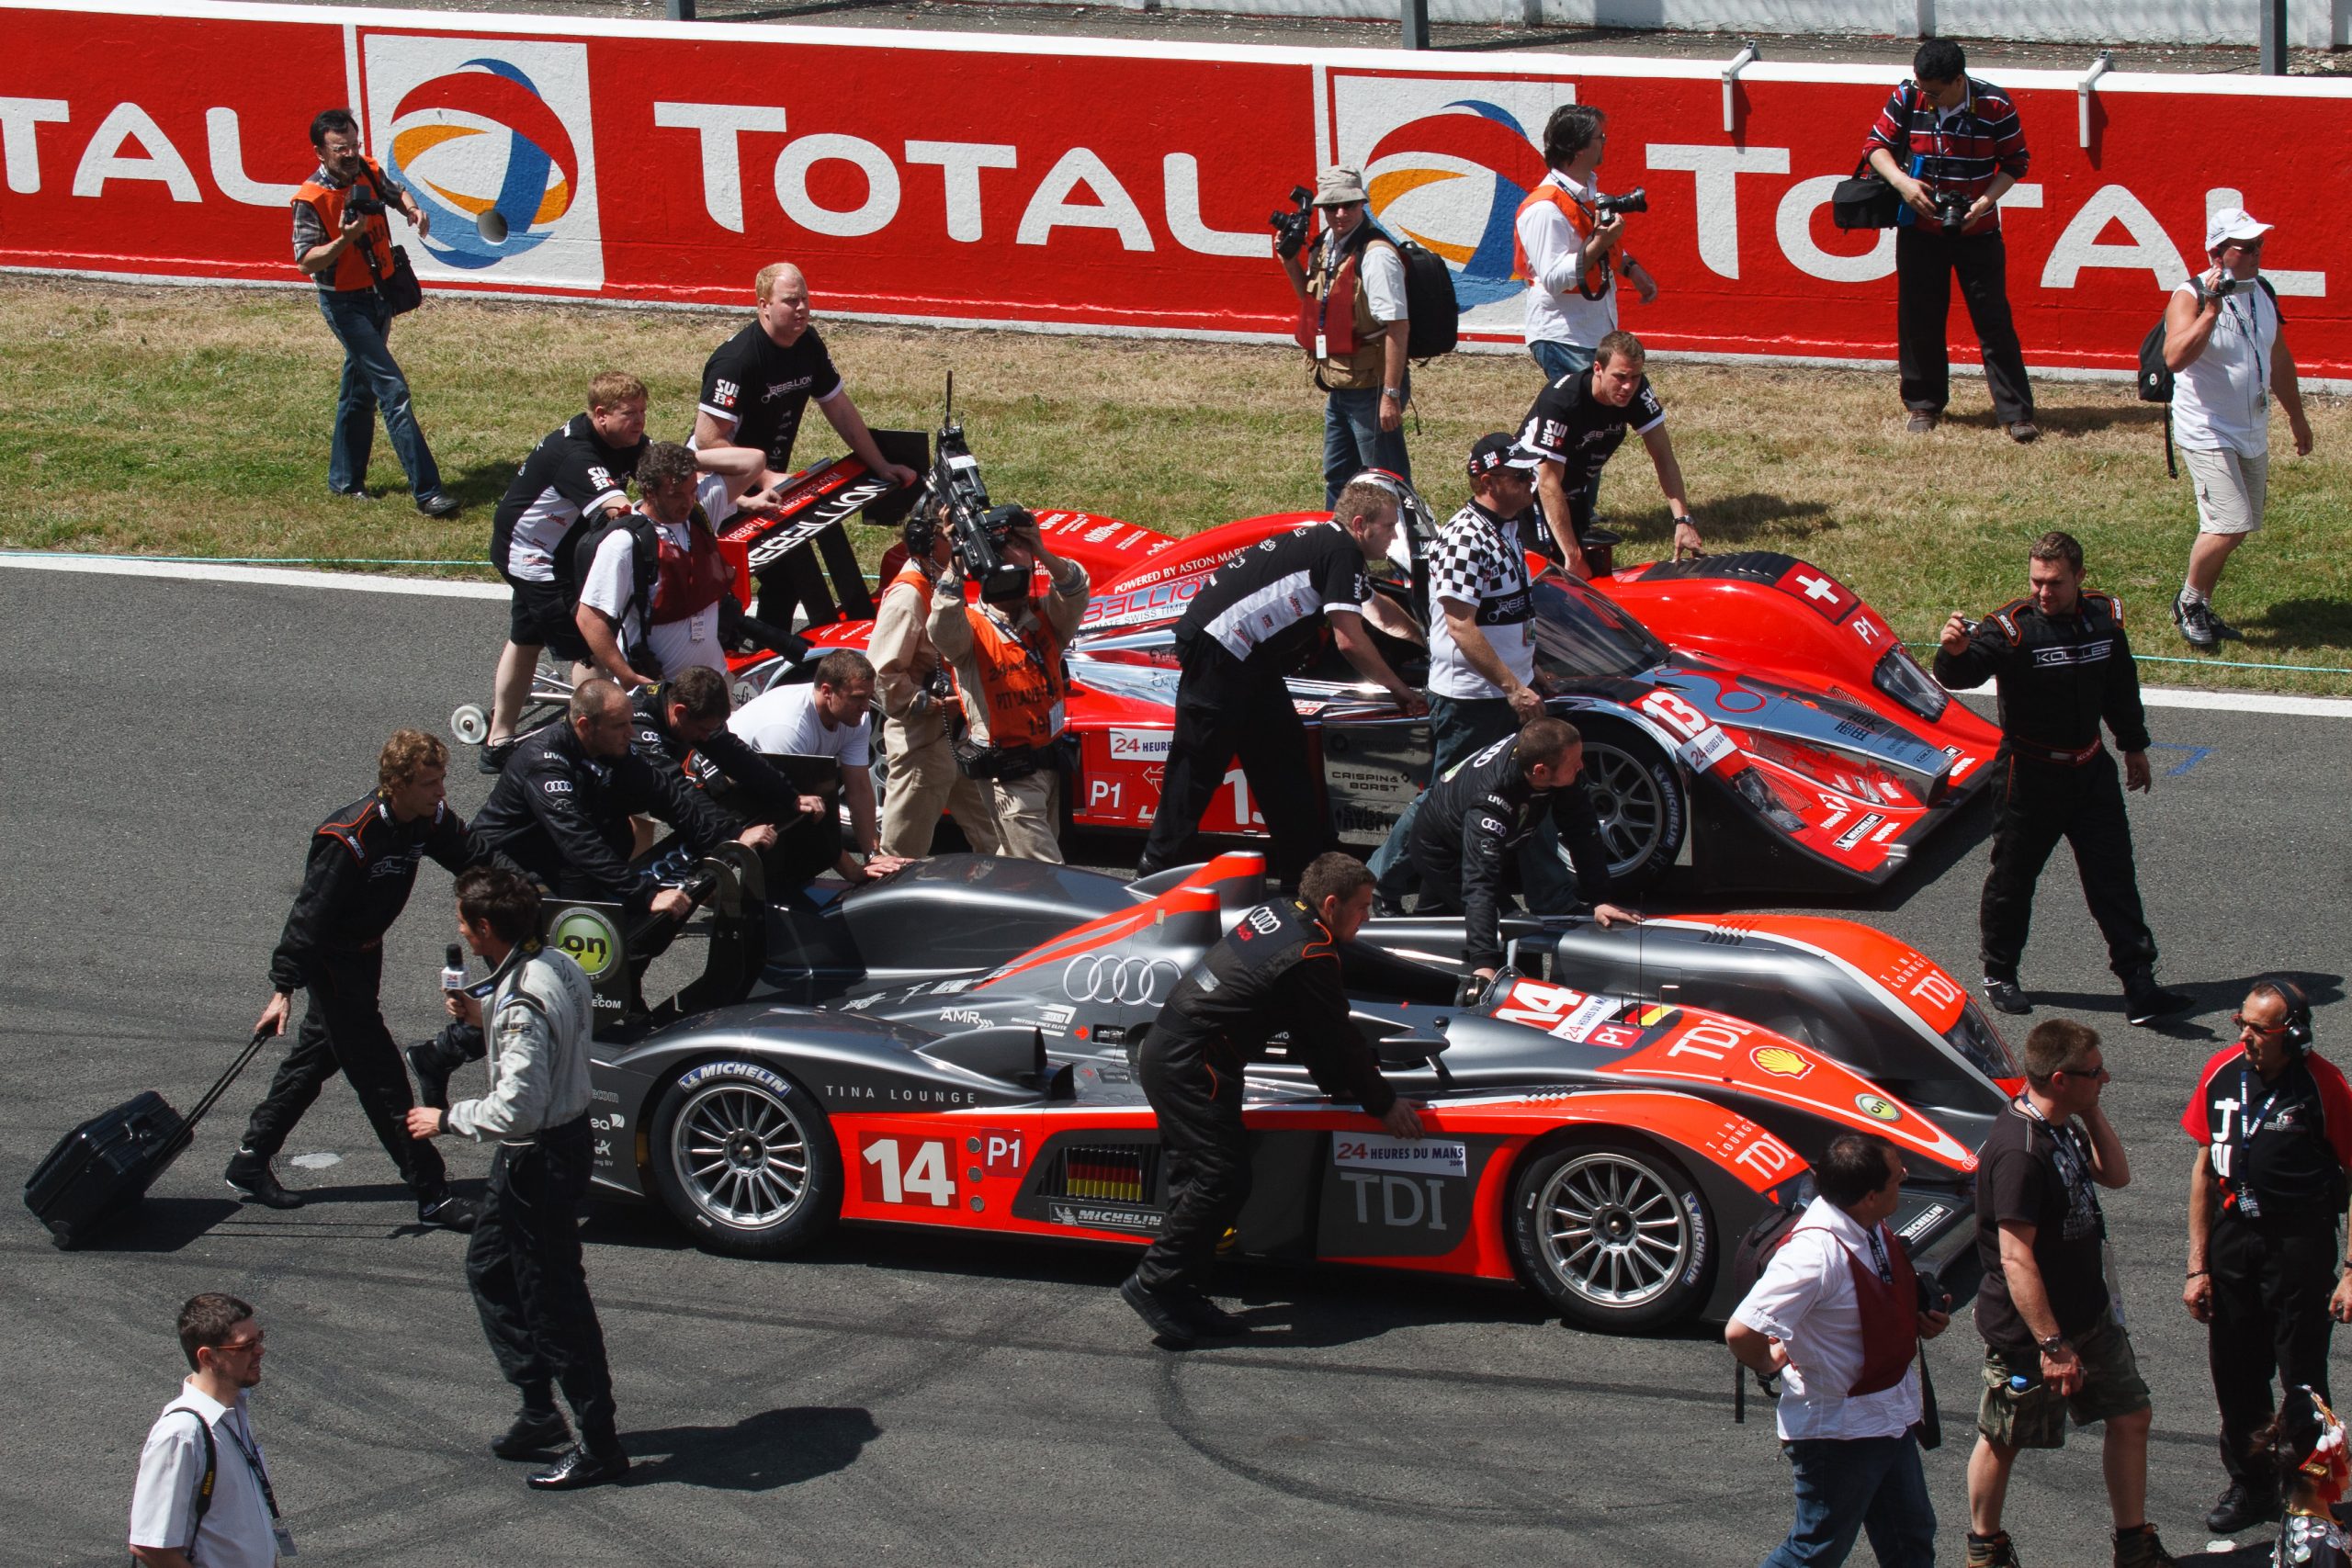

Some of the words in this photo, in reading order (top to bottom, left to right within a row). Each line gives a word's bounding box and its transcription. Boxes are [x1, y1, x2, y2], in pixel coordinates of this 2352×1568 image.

[653, 102, 1274, 258] TOTAL
[1114, 571, 1161, 594] POWERED
[1163, 565, 1176, 578] BY
[1180, 556, 1215, 573] ASTON
[1125, 610, 1157, 626] SWISS
[1852, 615, 1880, 645] P1
[1642, 692, 1706, 739] 13
[1114, 738, 1140, 753] 24
[1690, 746, 1708, 768] 24
[1090, 780, 1121, 808] P1
[1223, 769, 1266, 824] 1
[1661, 780, 1680, 848] MICHELIN
[560, 934, 607, 958] on
[1495, 981, 1584, 1022] 14
[1909, 969, 1962, 1010] TDI
[939, 1009, 980, 1025] AMR
[1563, 1025, 1585, 1040] 24
[1594, 1026, 1634, 1046] P1
[1667, 1019, 1753, 1060] TDI
[699, 1060, 789, 1096] MICHELIN
[826, 1085, 875, 1100] TINA
[891, 1088, 976, 1104] LOUNGE
[1870, 1100, 1887, 1114] on
[987, 1137, 1021, 1168] P1
[1337, 1142, 1368, 1160] 24
[1370, 1147, 1410, 1160] HEURES
[1413, 1147, 1429, 1159] DU
[1431, 1147, 1464, 1160] MANS
[1735, 1132, 1796, 1180] TDI
[862, 1138, 956, 1207] 14
[1339, 1171, 1448, 1231] TDI
[1078, 1209, 1163, 1226] MICHELIN
[1686, 1213, 1706, 1286] MICHELIN
